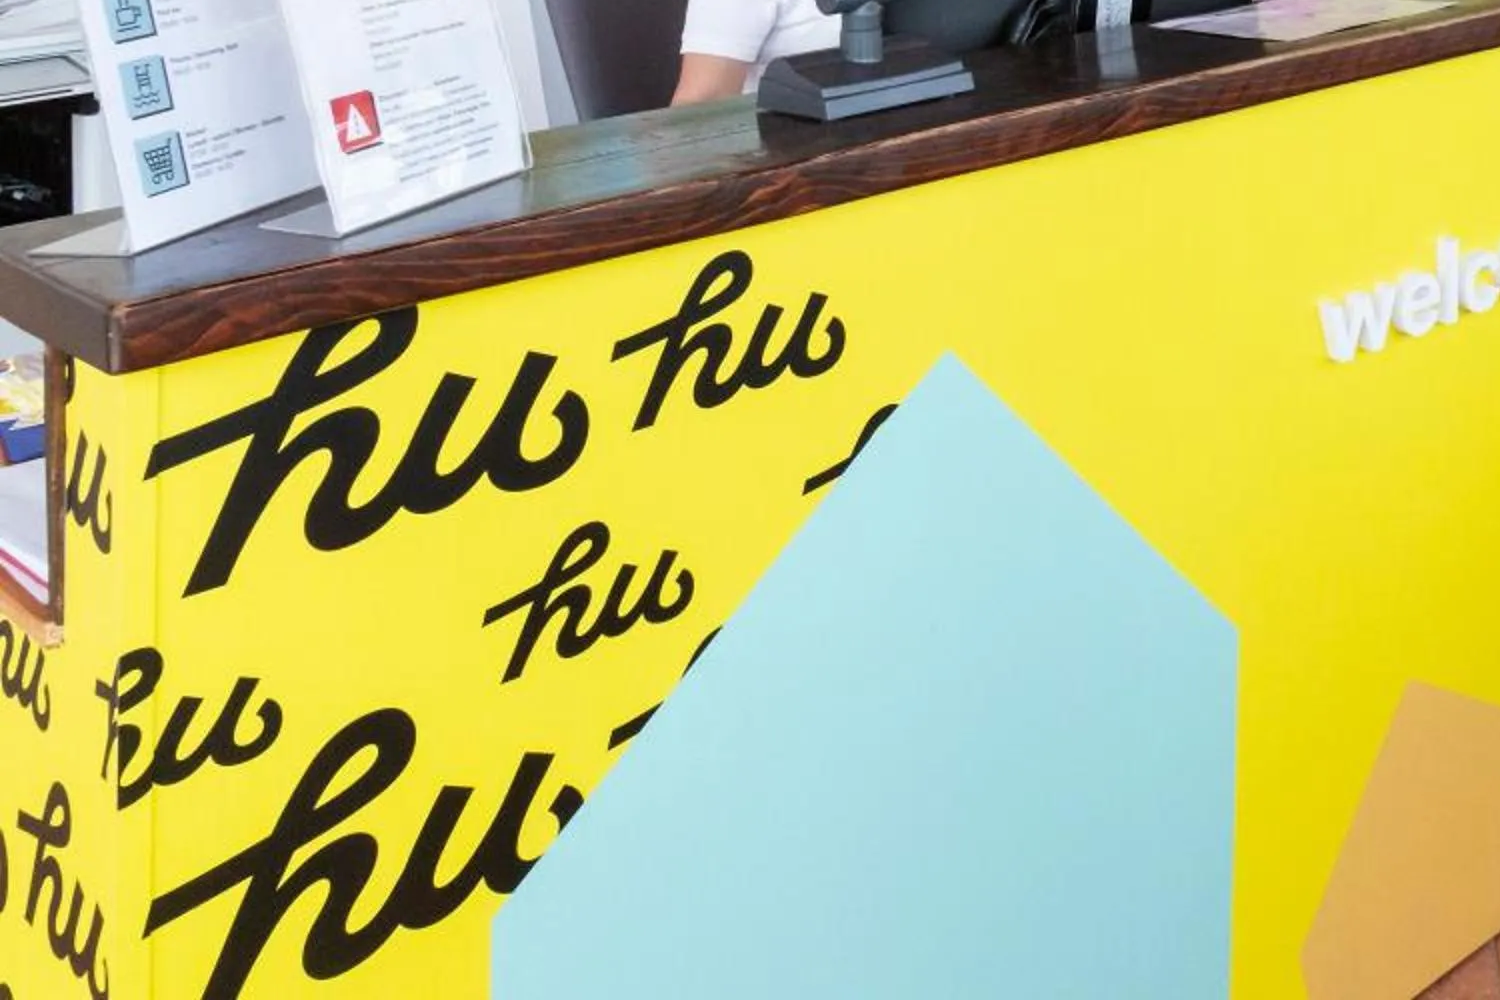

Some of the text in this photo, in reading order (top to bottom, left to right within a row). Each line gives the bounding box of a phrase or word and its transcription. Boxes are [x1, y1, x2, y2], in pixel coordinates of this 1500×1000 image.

[609, 250, 846, 431] hu
[143, 306, 590, 598] hu
[482, 520, 696, 685] hu
[95, 646, 284, 812] hu
[16, 780, 110, 1000] hu
[143, 707, 586, 1000] hu
